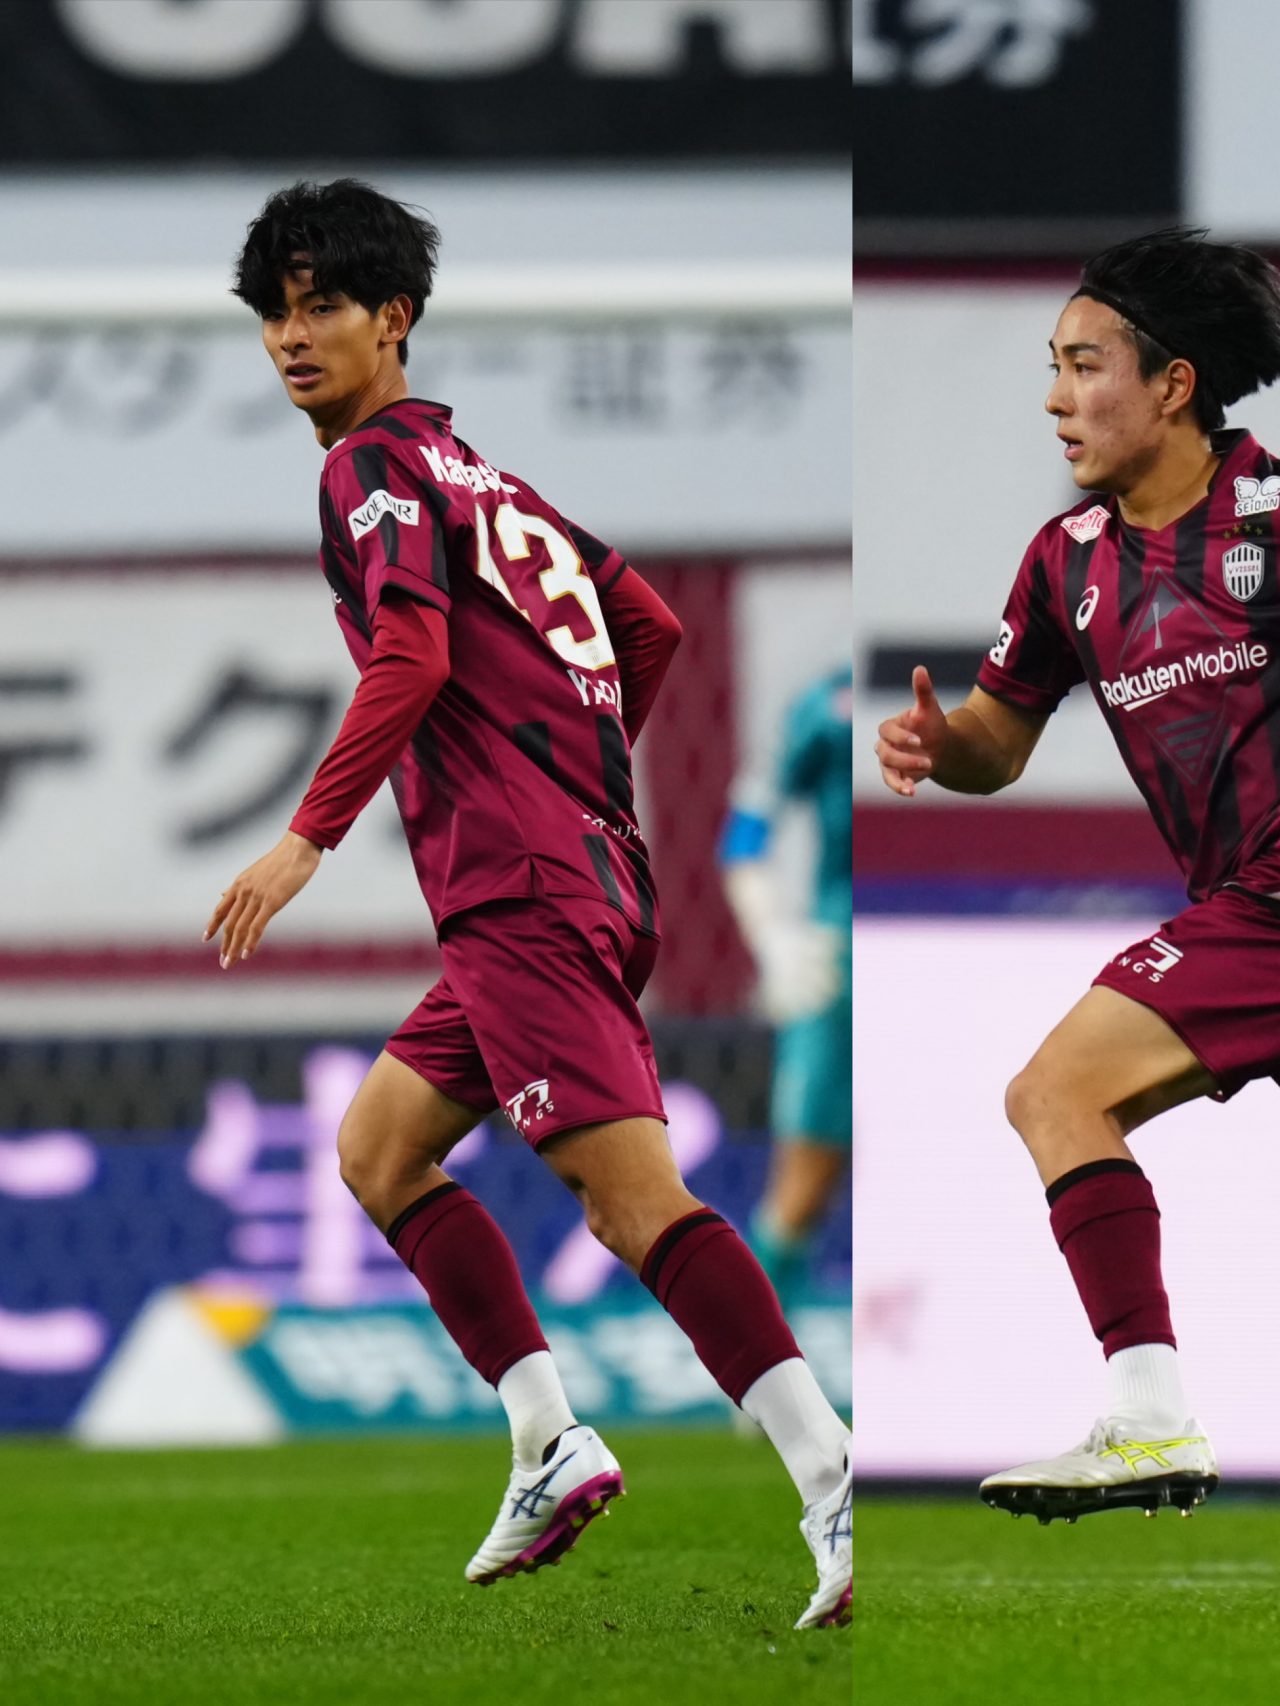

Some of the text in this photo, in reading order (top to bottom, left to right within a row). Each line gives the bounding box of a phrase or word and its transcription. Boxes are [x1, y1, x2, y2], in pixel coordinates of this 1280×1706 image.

[352, 494, 412, 533] NOEVIR
[1100, 641, 1269, 709] Rakuten Mobile
